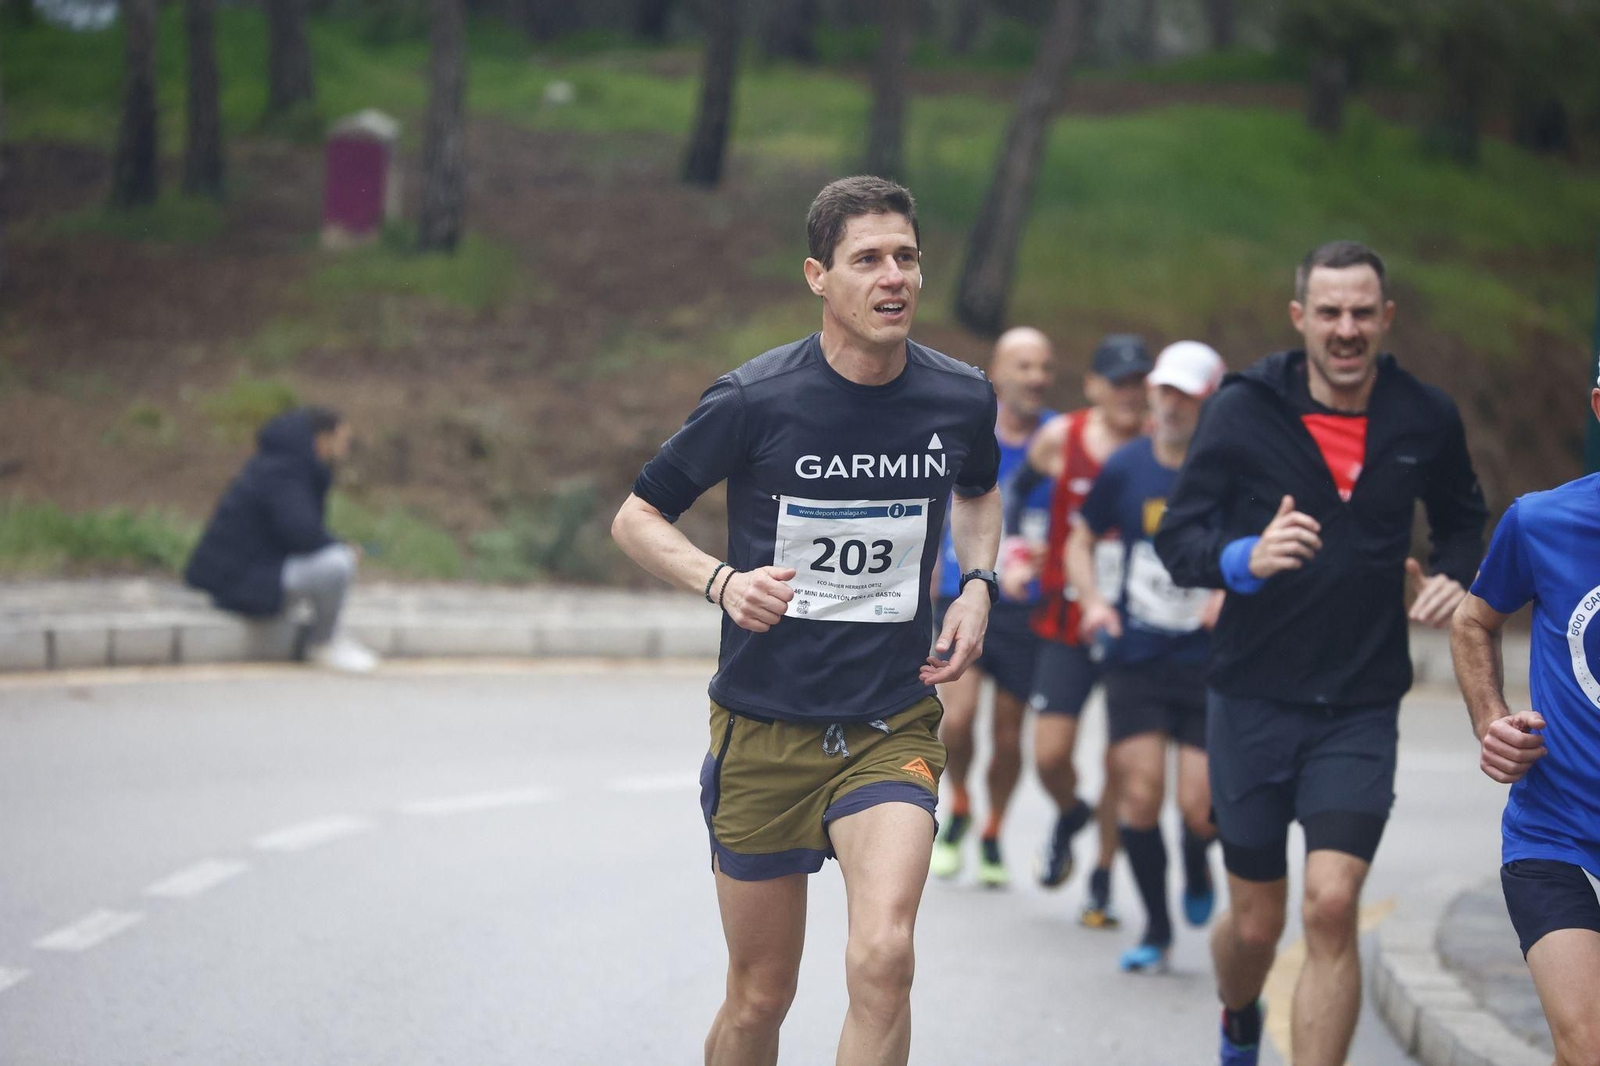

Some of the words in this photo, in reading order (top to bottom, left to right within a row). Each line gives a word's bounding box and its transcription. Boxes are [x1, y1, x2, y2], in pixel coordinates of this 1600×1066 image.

[795, 453, 947, 479] GARMIN
[810, 537, 893, 575] 203
[819, 592, 850, 601] MARATÓN
[1571, 613, 1585, 636] 500
